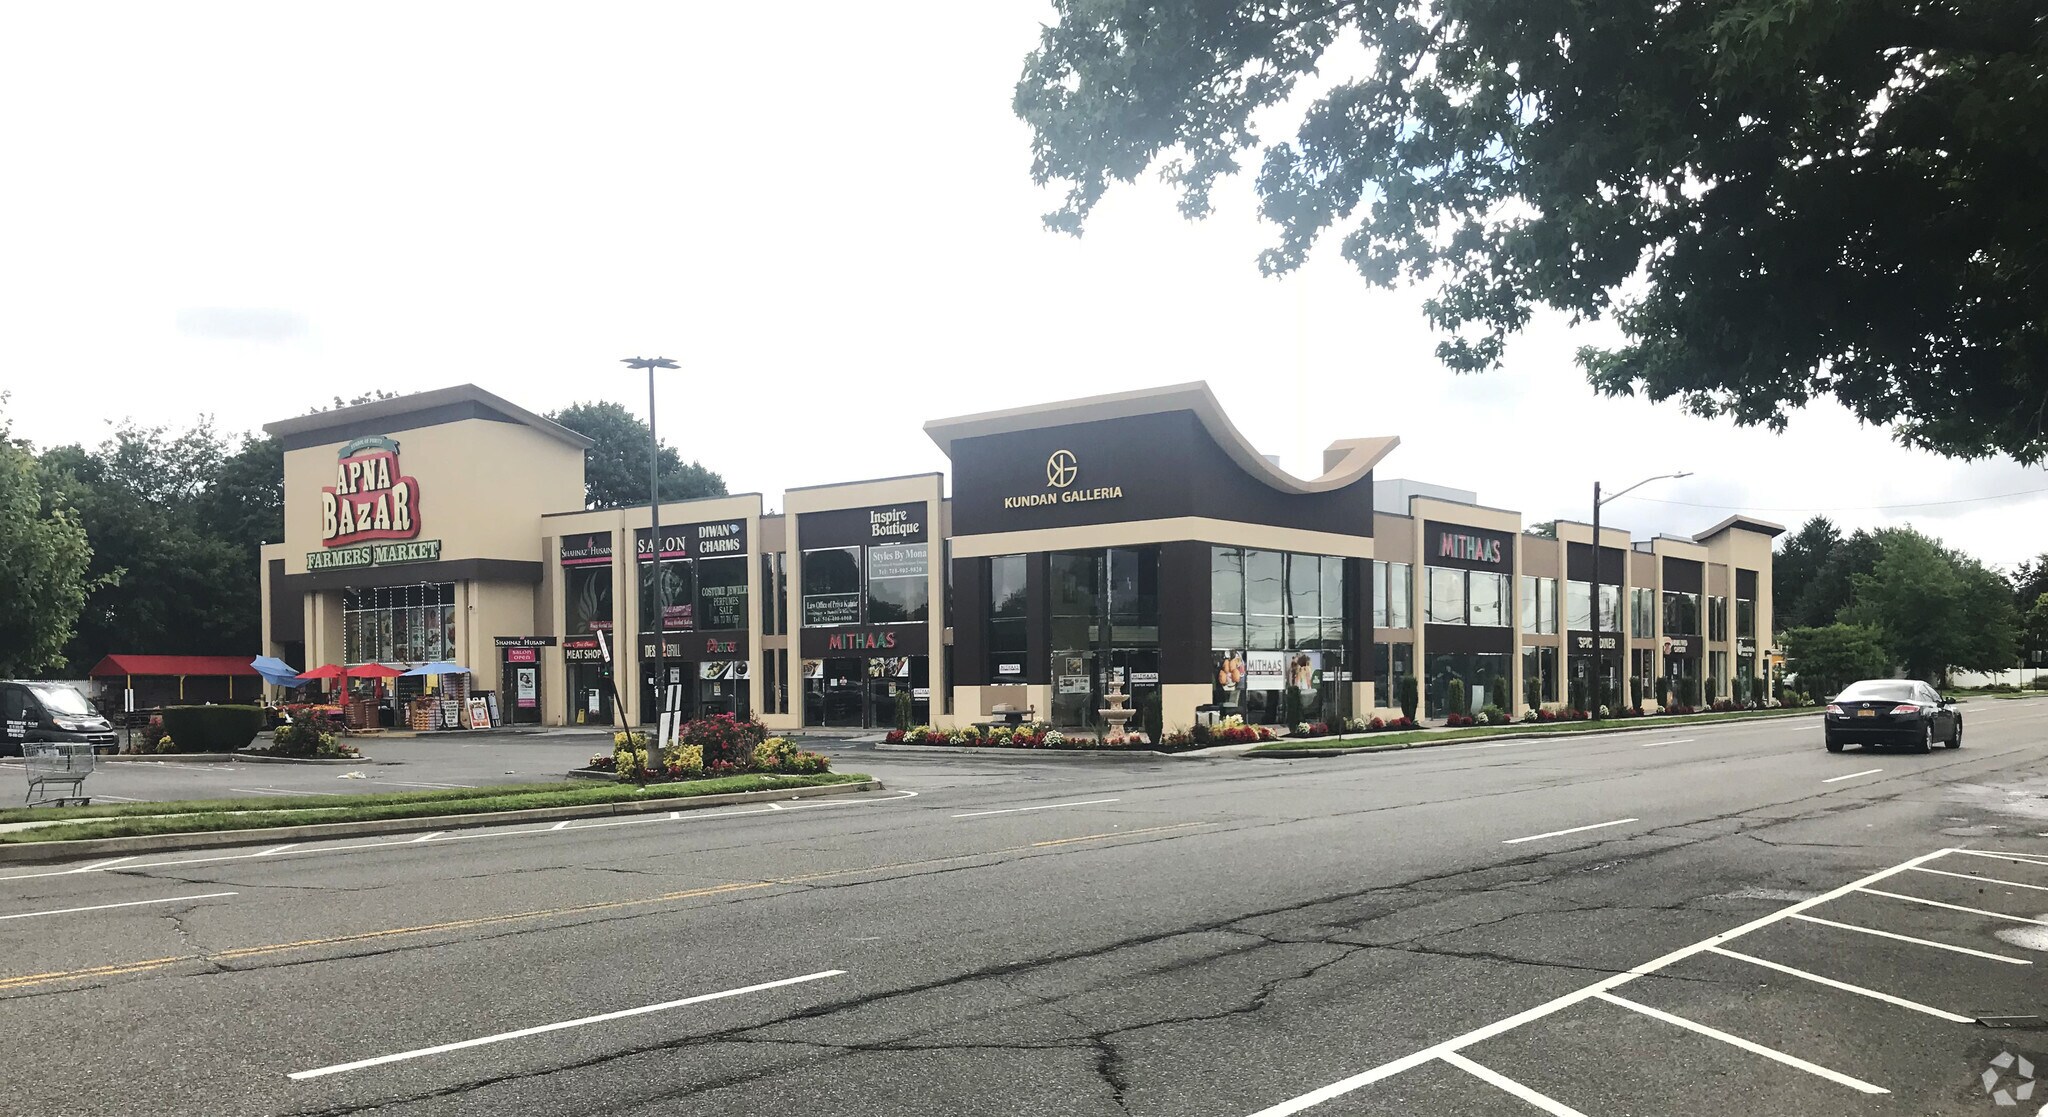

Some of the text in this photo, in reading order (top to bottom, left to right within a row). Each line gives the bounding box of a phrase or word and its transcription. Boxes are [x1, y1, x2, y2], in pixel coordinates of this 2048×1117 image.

[335, 457, 391, 495] APNA
[1004, 486, 1123, 509] KUNDAN GALLERIA
[322, 481, 411, 540] BAZAR
[870, 508, 907, 525] Inspire
[698, 523, 730, 539] DIWAN
[871, 521, 919, 537] Boutique
[699, 537, 740, 553] CHARMS
[1438, 532, 1501, 564] MITHAAS
[307, 540, 438, 570] FARMERS MARKET
[872, 549, 927, 563] Styles By Mona
[713, 596, 739, 607] PERFUMES
[719, 606, 733, 615] SALE
[829, 632, 896, 650] MITHAAS
[1578, 636, 1616, 650] SPIC DINER
[566, 649, 602, 659] MEAT SHOP
[644, 643, 681, 658] DES GRILL
[1247, 660, 1282, 671] MITHAAS
